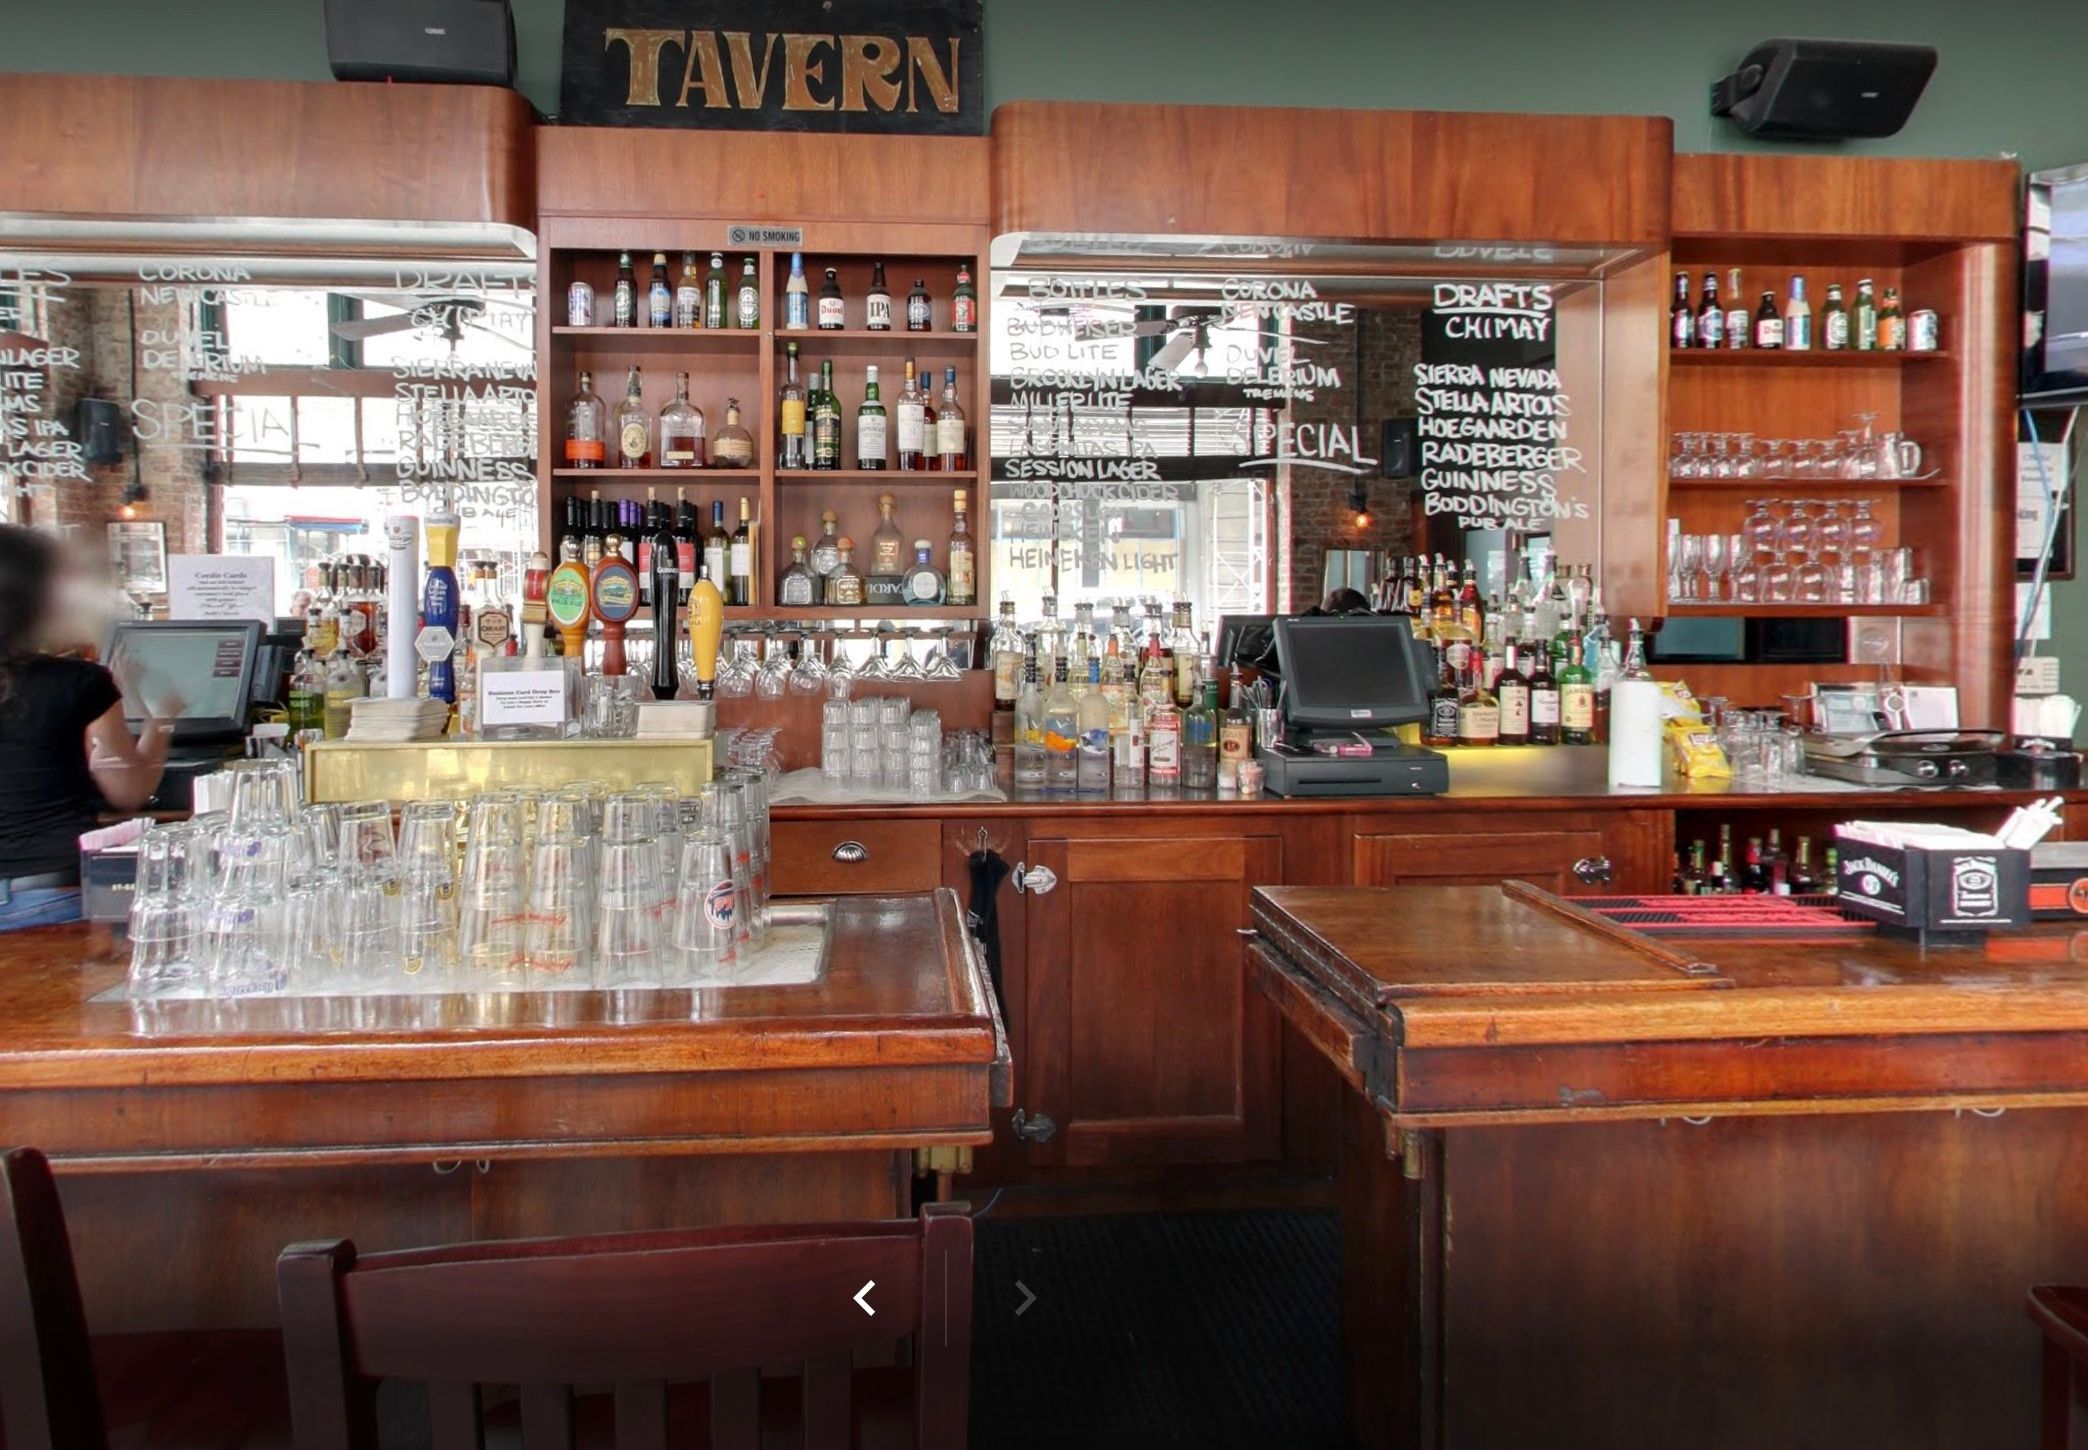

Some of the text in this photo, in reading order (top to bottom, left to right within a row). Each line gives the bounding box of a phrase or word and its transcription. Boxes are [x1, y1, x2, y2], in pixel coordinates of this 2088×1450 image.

[604, 28, 960, 113] TAVERN
[749, 231, 800, 242] NO SMOKING
[139, 264, 252, 282] CORONA
[1028, 277, 1147, 301] BOTTLES
[1222, 278, 1317, 300] CORONA
[1433, 284, 1553, 310] DRAFTS
[870, 302, 890, 318] IPA
[1007, 317, 1138, 338] BUDWEISER
[1445, 316, 1551, 341] CHIMAY
[1010, 343, 1119, 360] BUD LITE
[1227, 345, 1311, 364] DUVEL
[391, 356, 482, 381] SIERRA
[1010, 366, 1183, 392] BROOKLYN LAGER
[1413, 363, 1562, 389] SIERRA NEVADA
[395, 382, 537, 406] STELLA ARTO
[1010, 391, 1135, 411] MILLER LITE
[1414, 390, 1572, 417] STELLA ARTOIS
[35, 419, 69, 437] IPA
[1418, 418, 1568, 440] HOEGAARDEN
[8, 441, 84, 462] LAGER
[1231, 420, 1378, 465] SPECIAL
[1421, 440, 1587, 473] RADEBERGER
[22, 460, 93, 483] CIDER
[397, 456, 536, 486] GUINNESS
[1005, 459, 1162, 480] SESSION LAGER
[1009, 483, 1180, 501] WOODCHUCK CIDER
[1421, 468, 1556, 498] GUINNESS
[1424, 492, 1589, 518] BODDINGTON'S
[1459, 516, 1548, 531] PUB ALE
[1010, 547, 1179, 573] HEINEKEN LIGHT
